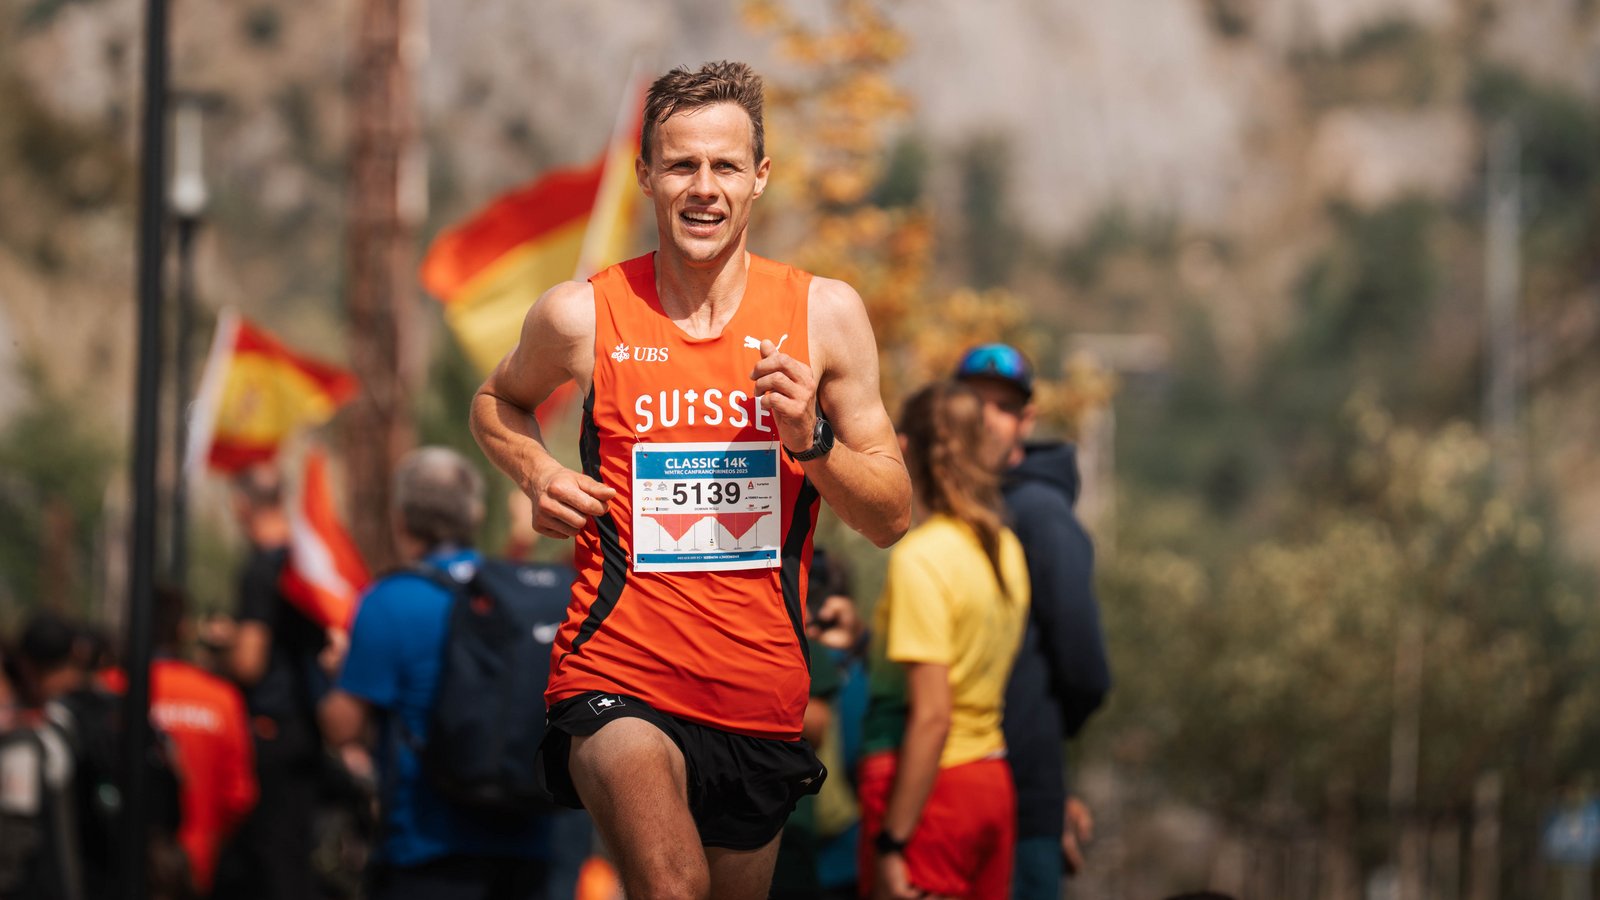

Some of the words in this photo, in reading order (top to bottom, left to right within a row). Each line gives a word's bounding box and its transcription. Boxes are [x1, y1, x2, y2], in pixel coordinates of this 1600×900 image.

[633, 346, 669, 362] UBS
[665, 457, 720, 469] CLASSIC
[723, 456, 748, 468] 14K
[672, 481, 741, 506] 5139
